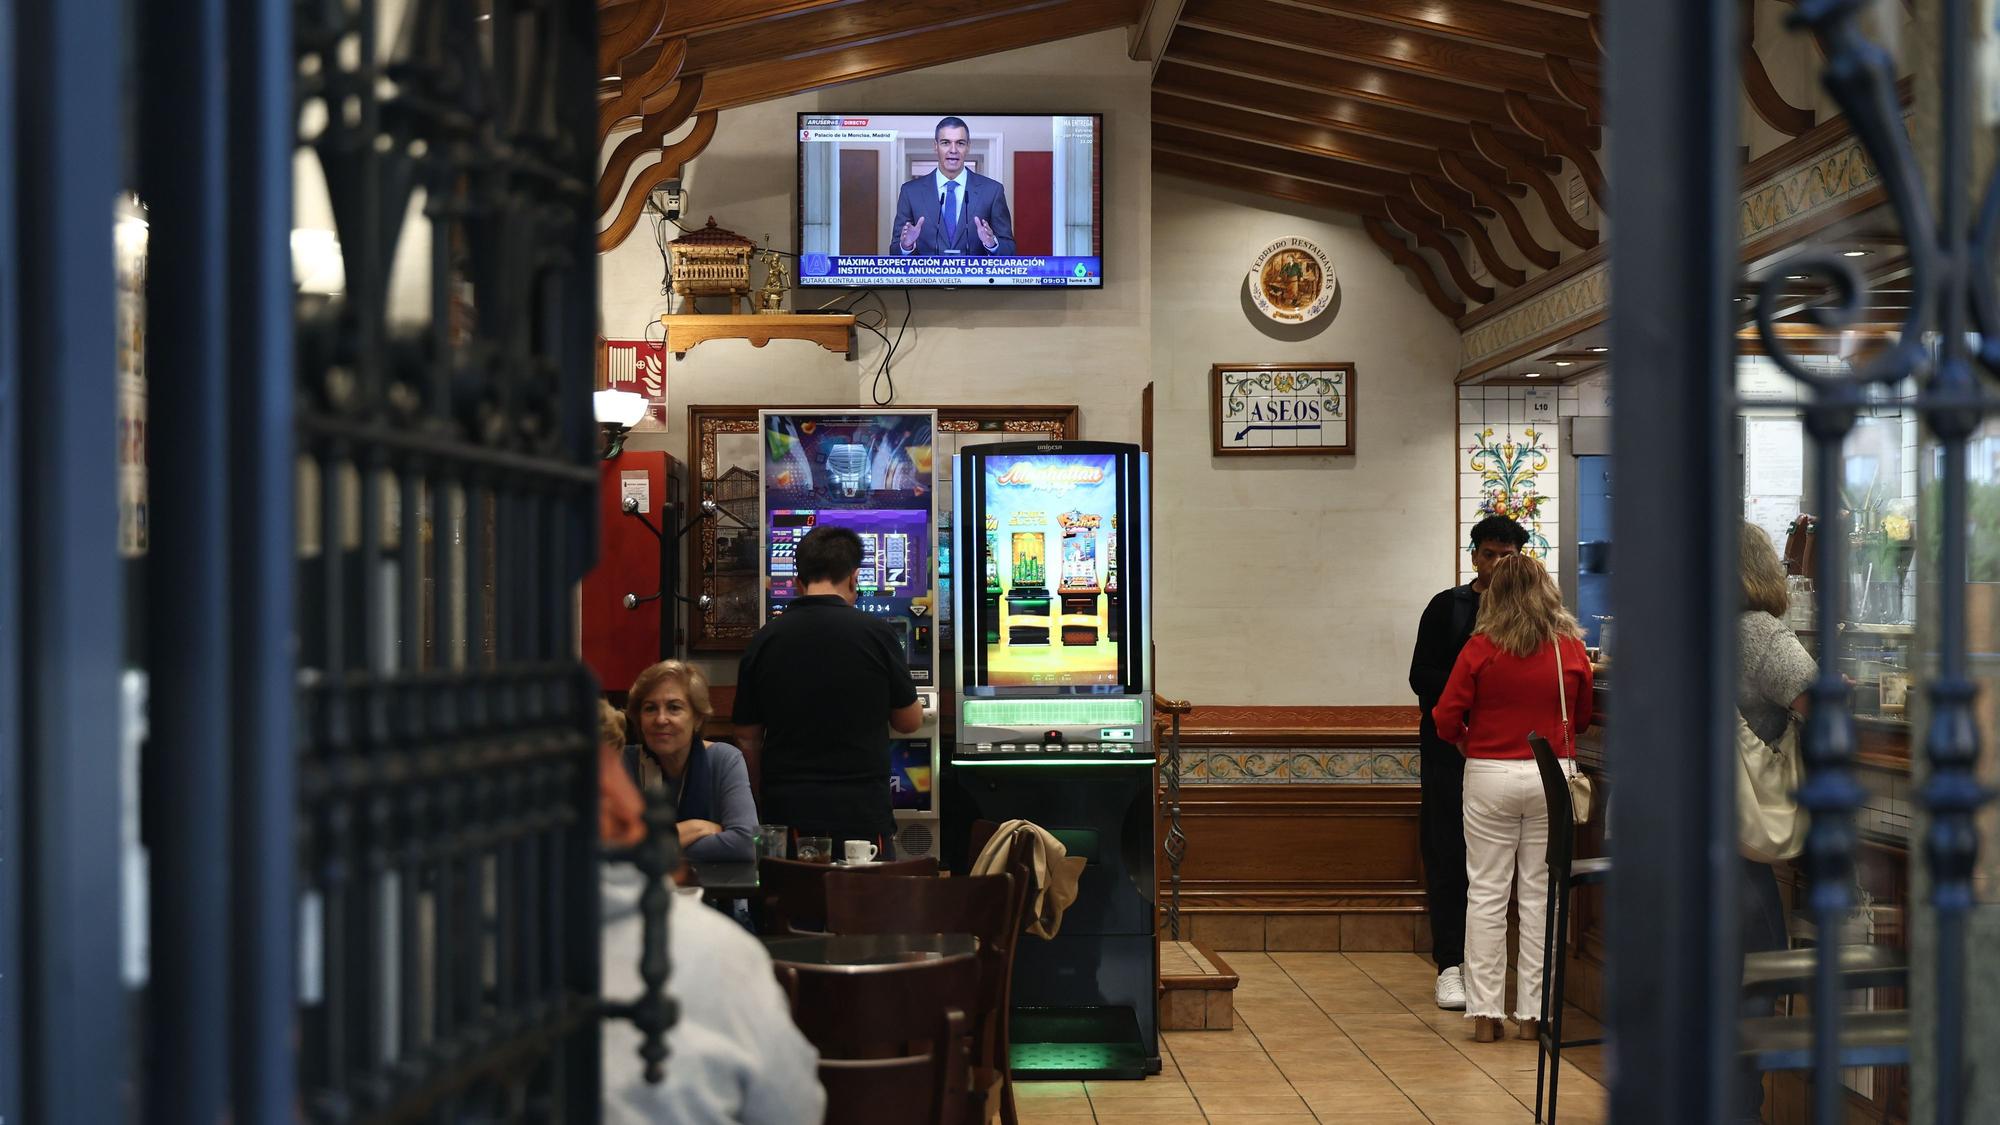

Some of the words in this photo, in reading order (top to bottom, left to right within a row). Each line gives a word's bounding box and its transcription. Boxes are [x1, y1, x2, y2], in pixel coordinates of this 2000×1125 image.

[838, 257, 876, 266] MÁXIMA
[877, 257, 940, 266] EXPECTACIÓN
[941, 258, 966, 266] ANTE
[967, 258, 980, 266] LA
[981, 257, 1045, 266] DECLARACIÓN
[1252, 240, 1287, 273] FERREIRO
[1291, 237, 1334, 290] RESTAURANTES
[838, 267, 907, 275] INSTITUCIONAL
[909, 267, 962, 275] ANUNCIADA
[964, 267, 984, 275] POR
[985, 265, 1028, 275] SÁNCHEZ
[1250, 399, 1320, 421] ASEOS
[1534, 403, 1549, 411] L10
